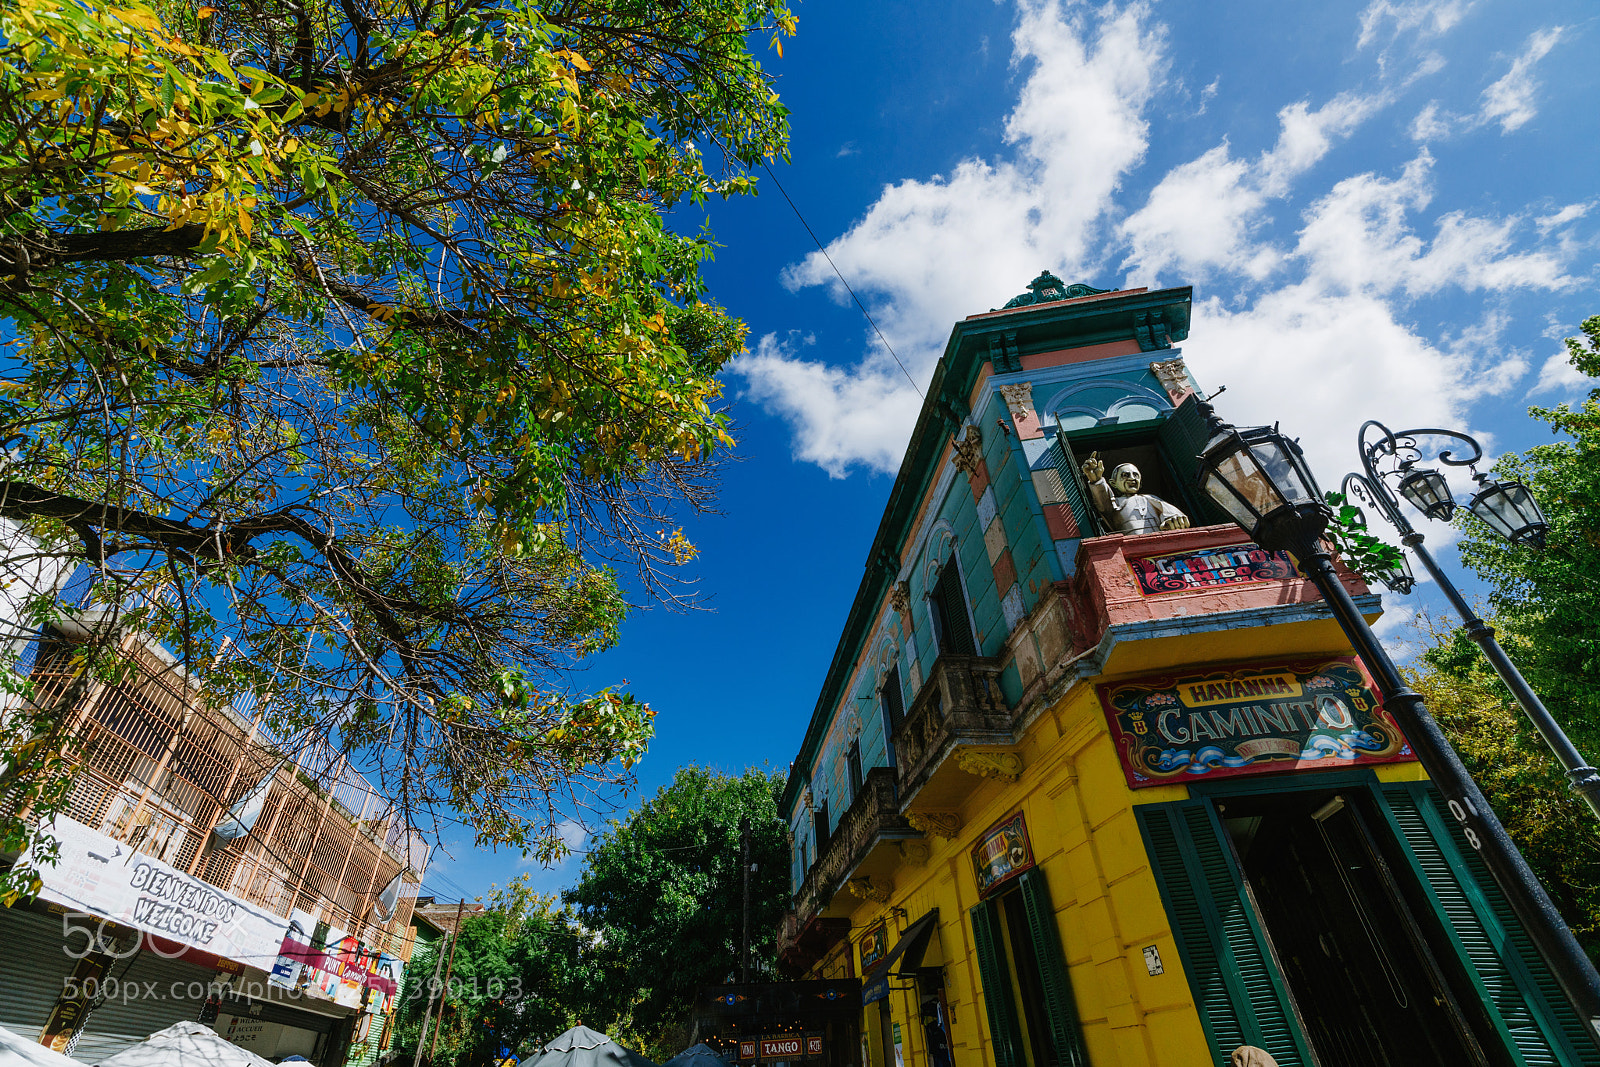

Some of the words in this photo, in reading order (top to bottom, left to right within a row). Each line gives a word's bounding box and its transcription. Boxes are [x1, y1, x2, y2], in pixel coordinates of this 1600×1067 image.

[1156, 550, 1267, 575] CAMINITO
[1182, 567, 1252, 582] AMIGO
[1189, 677, 1294, 702] HAVANNA
[1134, 721, 1146, 734] H
[1156, 693, 1353, 745] CAMINITO
[130, 863, 236, 923] BIENVENIDOS
[133, 897, 218, 945] WELCOME
[764, 1041, 799, 1055] TANGO
